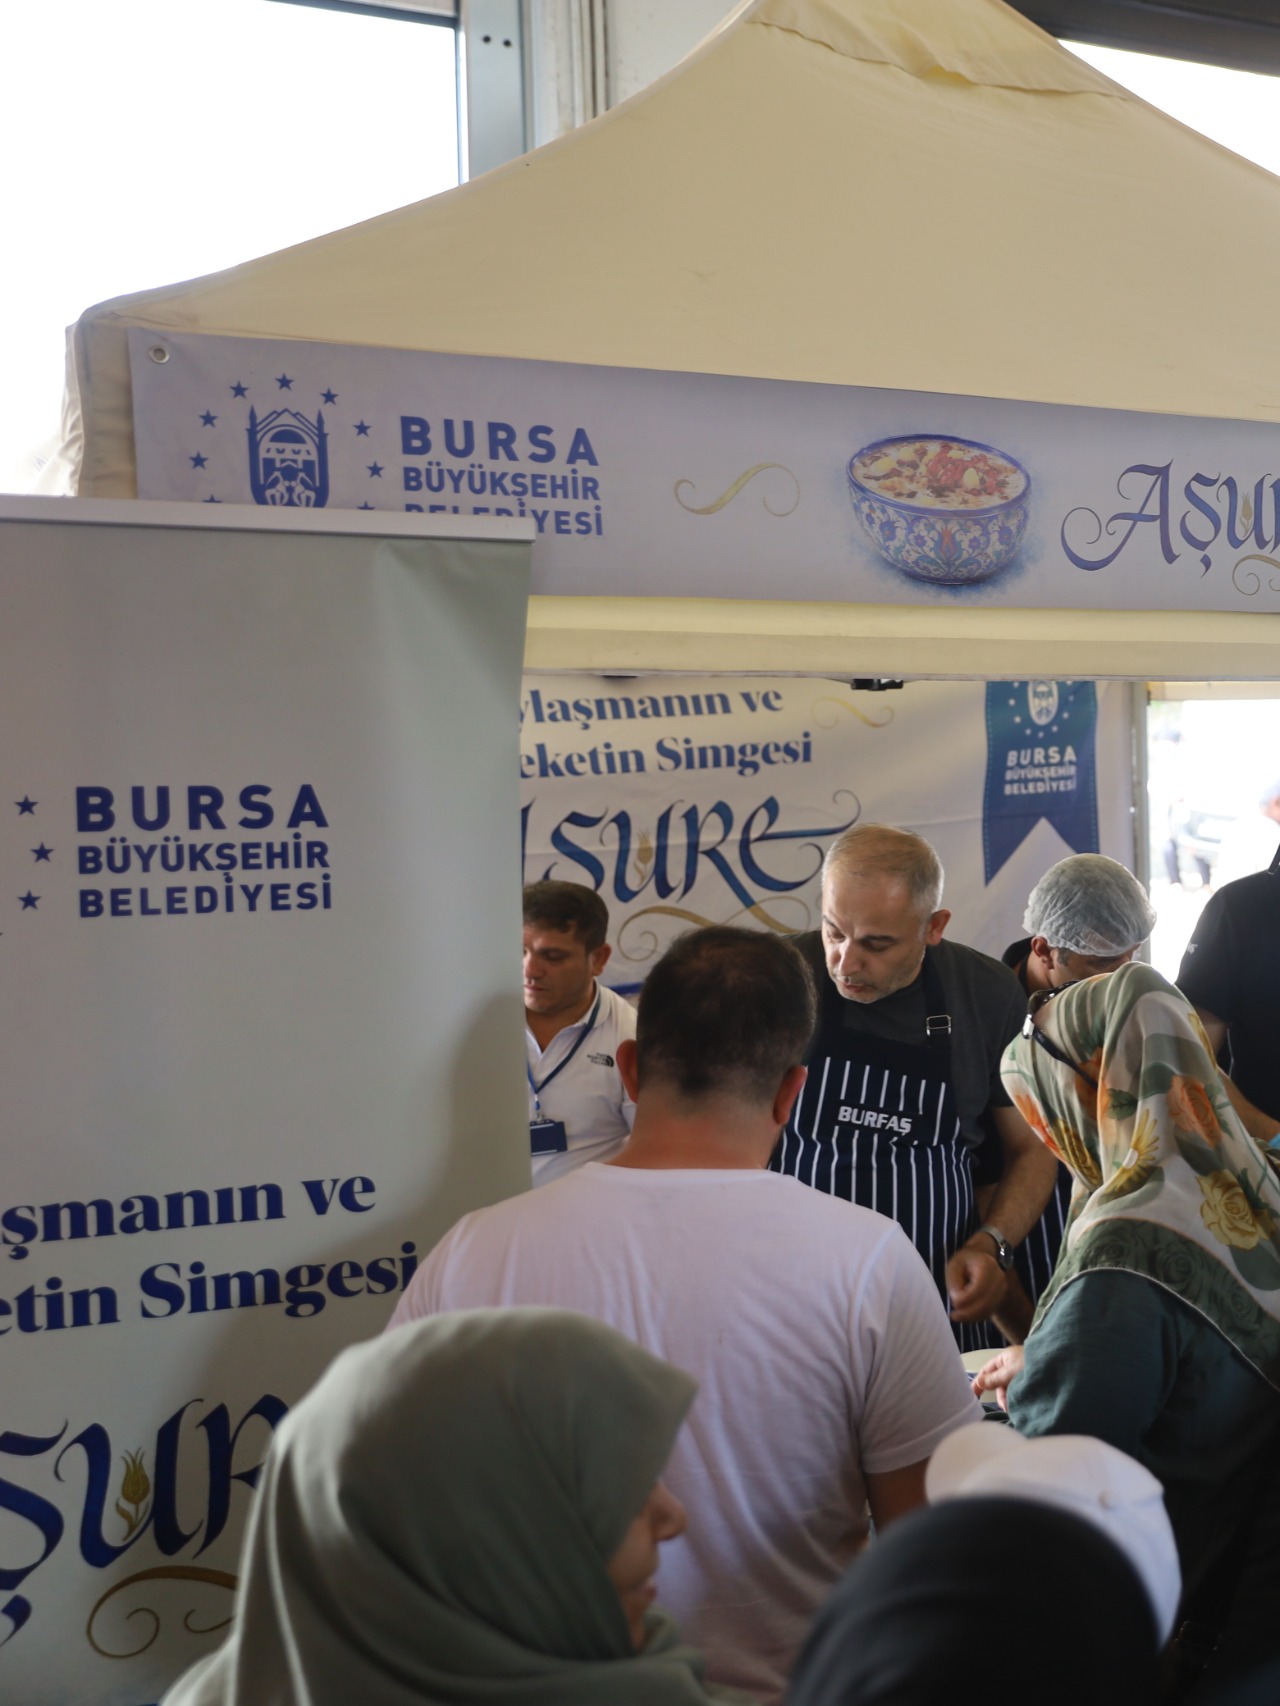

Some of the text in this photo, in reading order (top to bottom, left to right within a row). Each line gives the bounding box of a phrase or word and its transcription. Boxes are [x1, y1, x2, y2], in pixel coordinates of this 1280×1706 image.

[400, 415, 599, 466] BURSA
[403, 460, 602, 501] BÜYÜKŞEHİR
[739, 690, 784, 713] ve
[655, 731, 813, 777] Simgesi
[1006, 744, 1078, 767] BURSA
[75, 784, 330, 833] BURSA
[77, 832, 331, 876] BÜYÜKŞEHİR
[79, 873, 333, 918] BELEDİYESİ
[837, 1105, 913, 1137] BURFAŞ
[0, 1175, 377, 1260] şmanın ve
[140, 1241, 419, 1318] Simgesi
